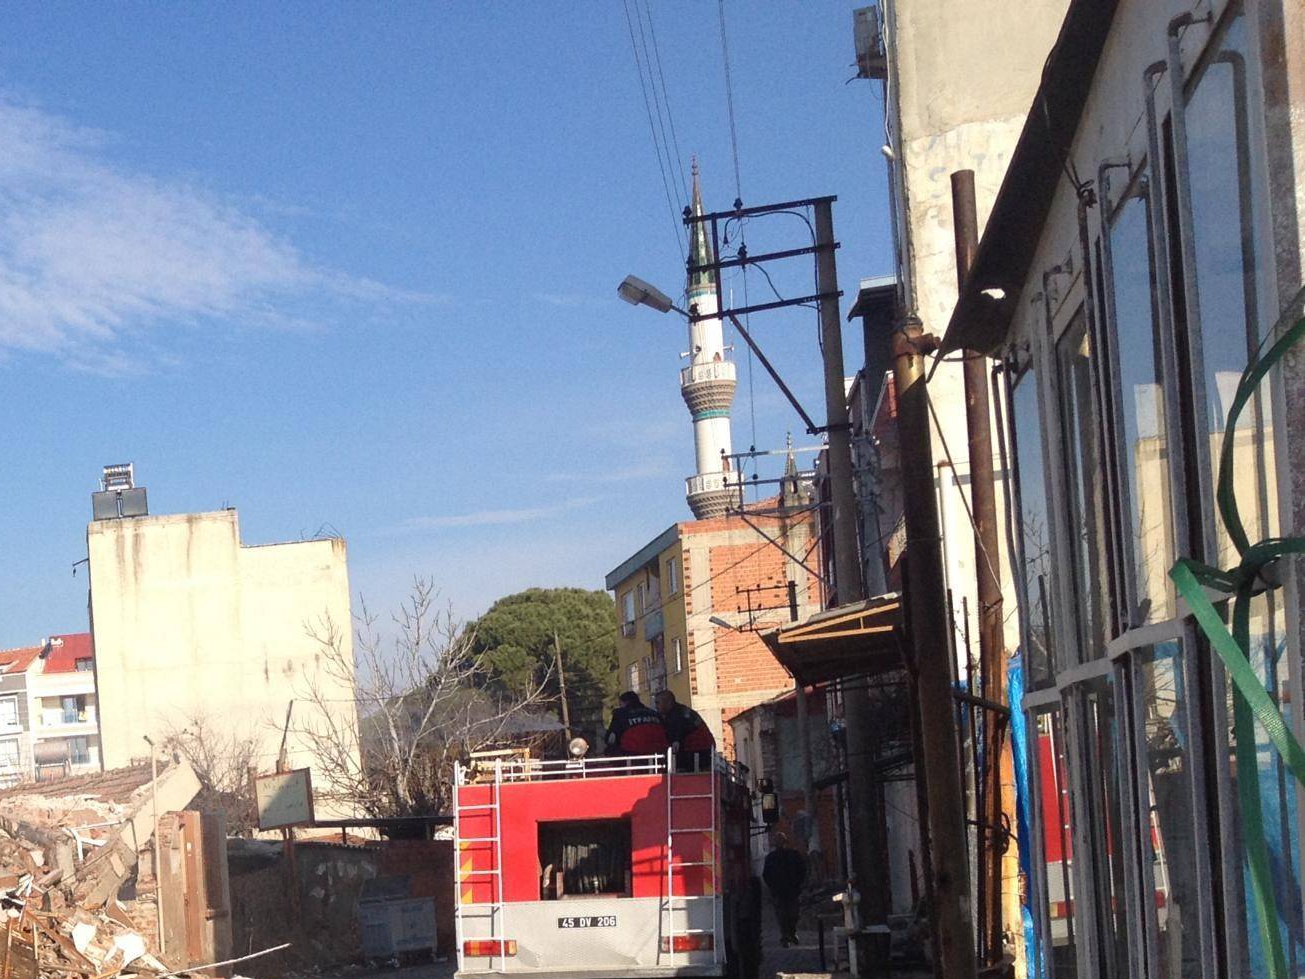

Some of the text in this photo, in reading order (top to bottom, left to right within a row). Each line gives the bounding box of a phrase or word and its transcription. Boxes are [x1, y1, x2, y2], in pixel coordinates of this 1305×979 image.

[562, 916, 616, 928] 45 DV 206
